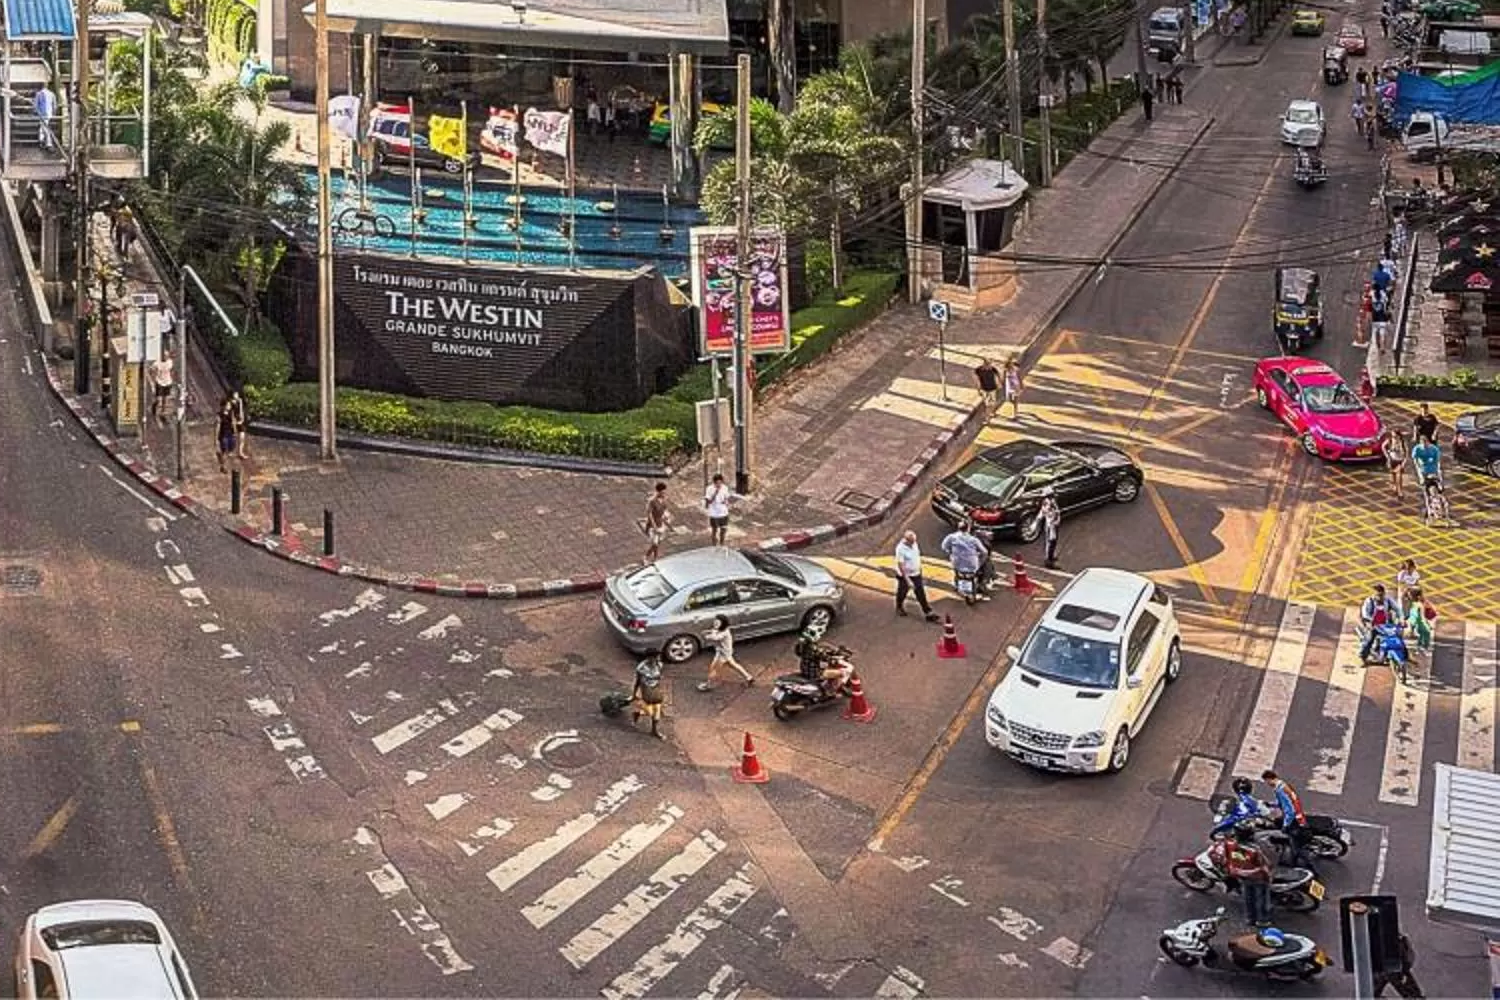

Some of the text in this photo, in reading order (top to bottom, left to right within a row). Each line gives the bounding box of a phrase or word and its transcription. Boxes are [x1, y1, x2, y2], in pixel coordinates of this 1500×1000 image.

[385, 291, 544, 330] THE WESTIN
[385, 319, 542, 346] GRANDE SUKHUMVIT
[431, 341, 493, 359] BANGKOK
